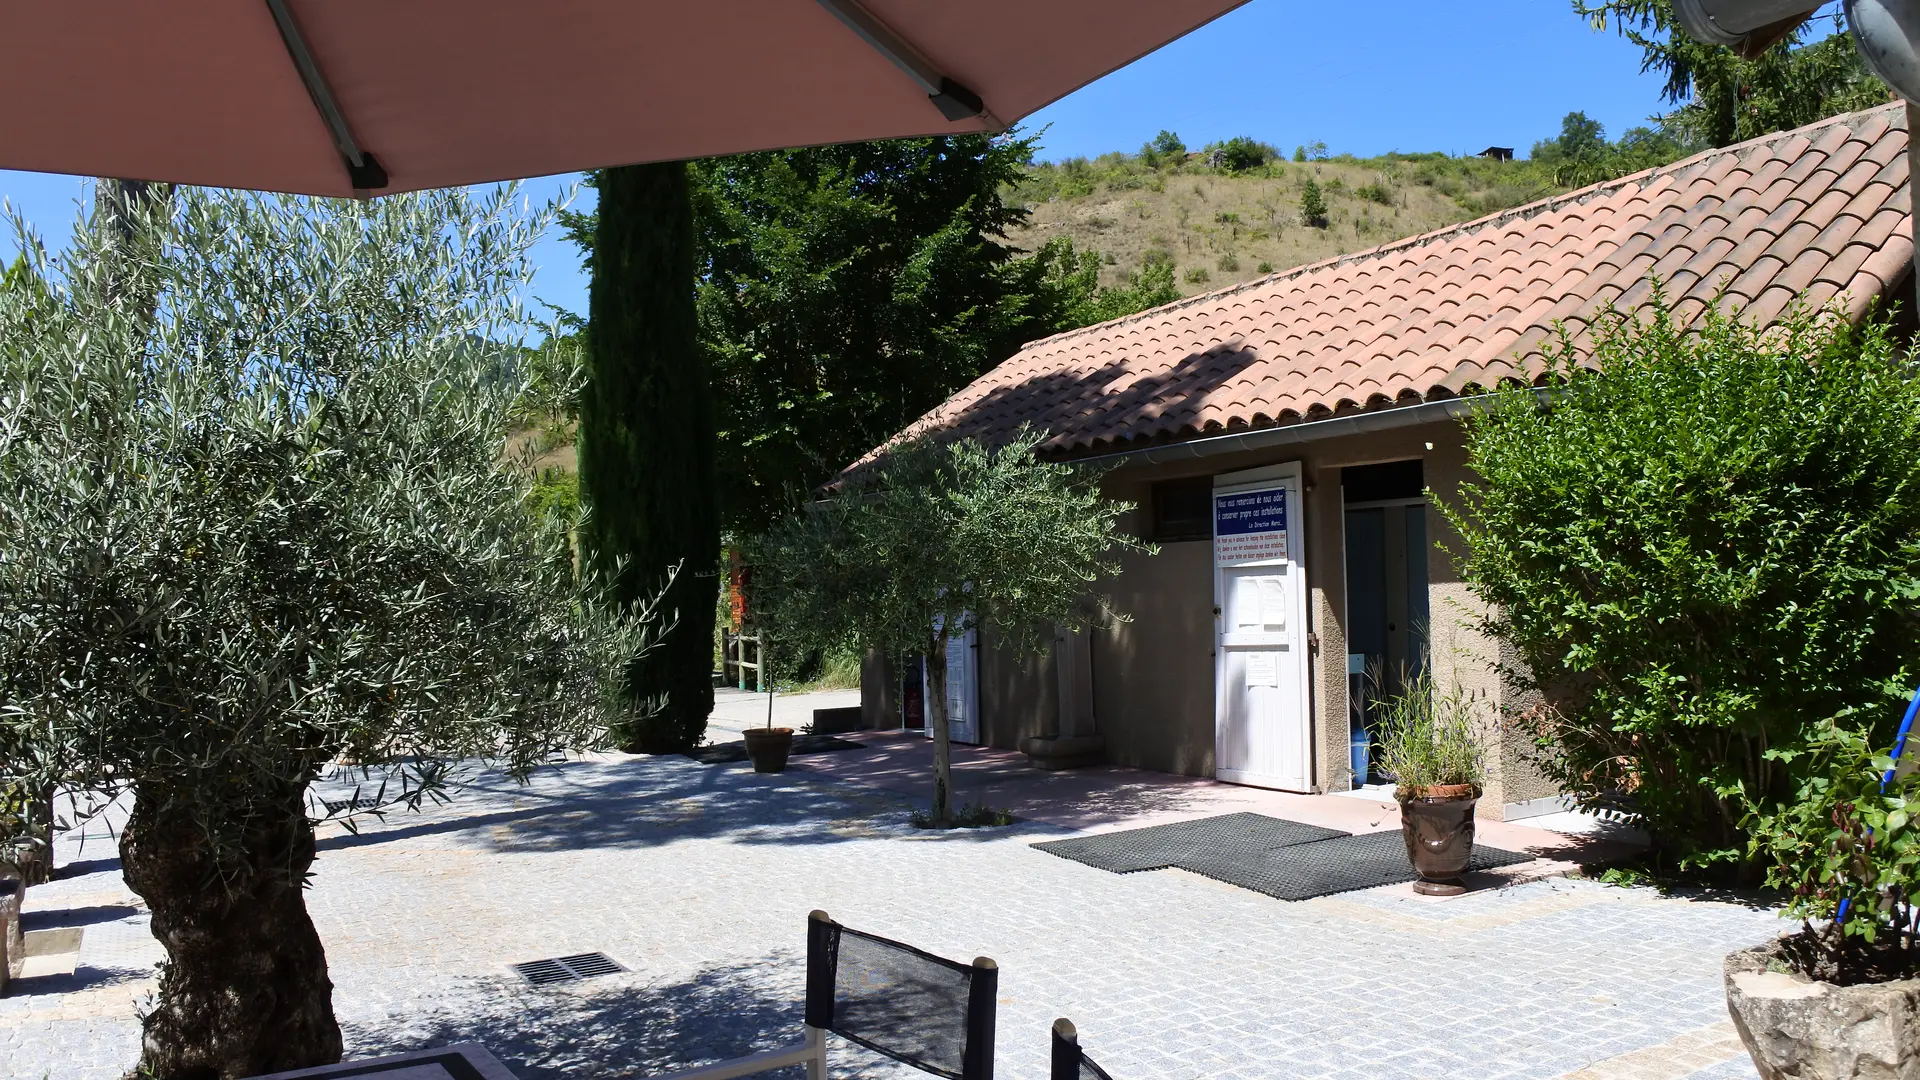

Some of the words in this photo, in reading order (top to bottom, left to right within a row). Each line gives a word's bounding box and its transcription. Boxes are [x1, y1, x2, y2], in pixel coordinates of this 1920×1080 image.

[1237, 497, 1255, 506] remercions
[1257, 495, 1261, 504] de
[1273, 493, 1283, 502] aider
[1240, 511, 1251, 520] propre
[1261, 506, 1283, 516] installations
